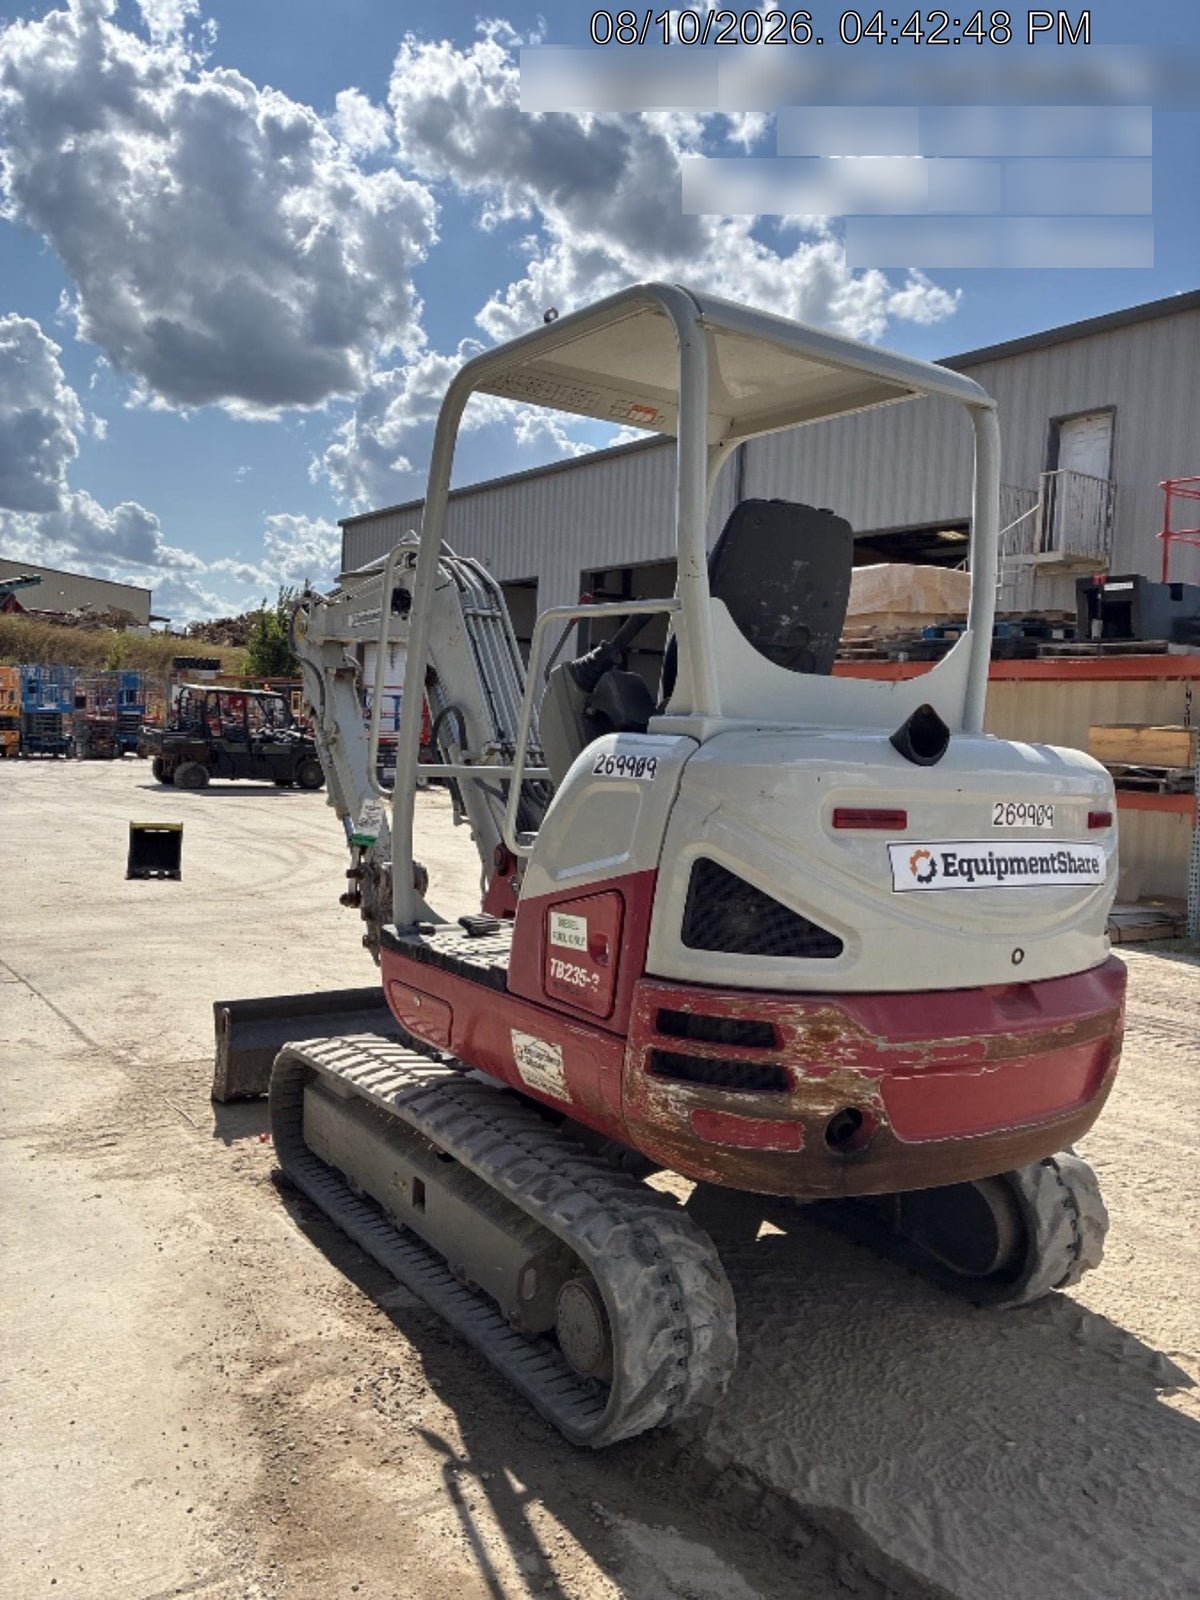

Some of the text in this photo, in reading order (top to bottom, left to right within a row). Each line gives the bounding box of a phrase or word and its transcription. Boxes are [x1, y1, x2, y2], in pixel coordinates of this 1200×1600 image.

[593, 753, 658, 779] 269909
[993, 802, 1054, 827] 269909
[940, 851, 1100, 882] EquipmentShare
